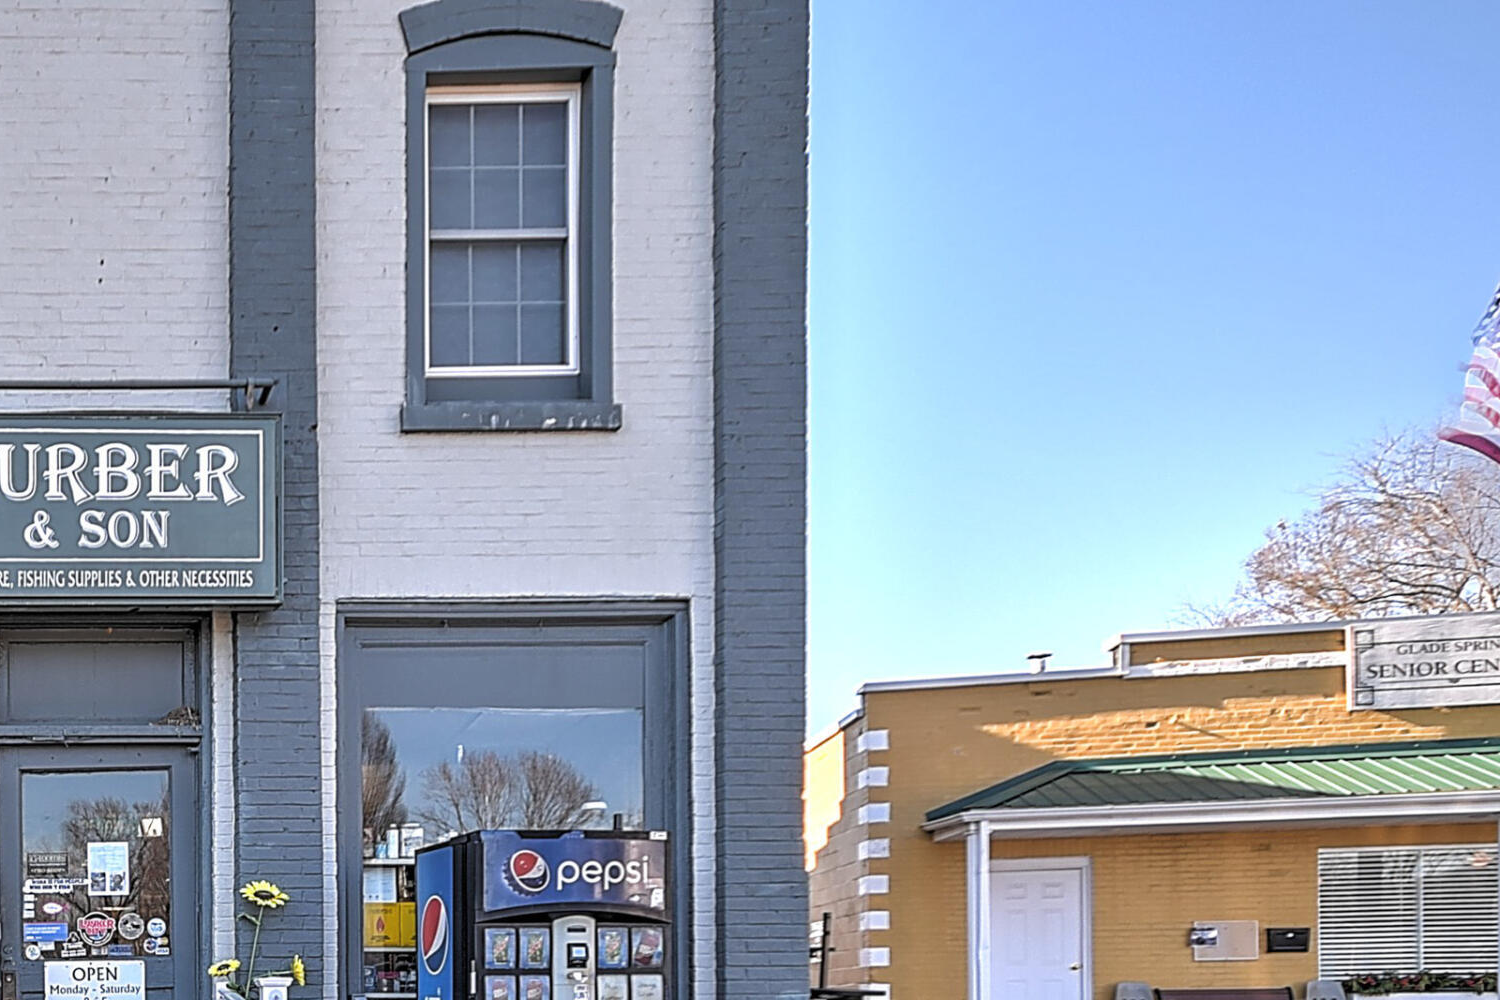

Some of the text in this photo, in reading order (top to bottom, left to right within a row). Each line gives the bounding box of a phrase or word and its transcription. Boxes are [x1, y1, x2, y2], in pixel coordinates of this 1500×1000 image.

[24, 510, 170, 548] & SON
[18, 570, 65, 588] FISHING
[67, 570, 122, 588] SUPPLIES
[126, 570, 136, 588] &
[139, 570, 179, 588] OTHER
[182, 570, 254, 587] NECESSITIES
[1396, 643, 1449, 655] GLADE
[1366, 661, 1448, 679] SENIOR
[556, 855, 649, 891] pepsi
[72, 967, 118, 981] OPEN
[50, 985, 89, 995] Monday
[100, 984, 140, 994] Saturday
